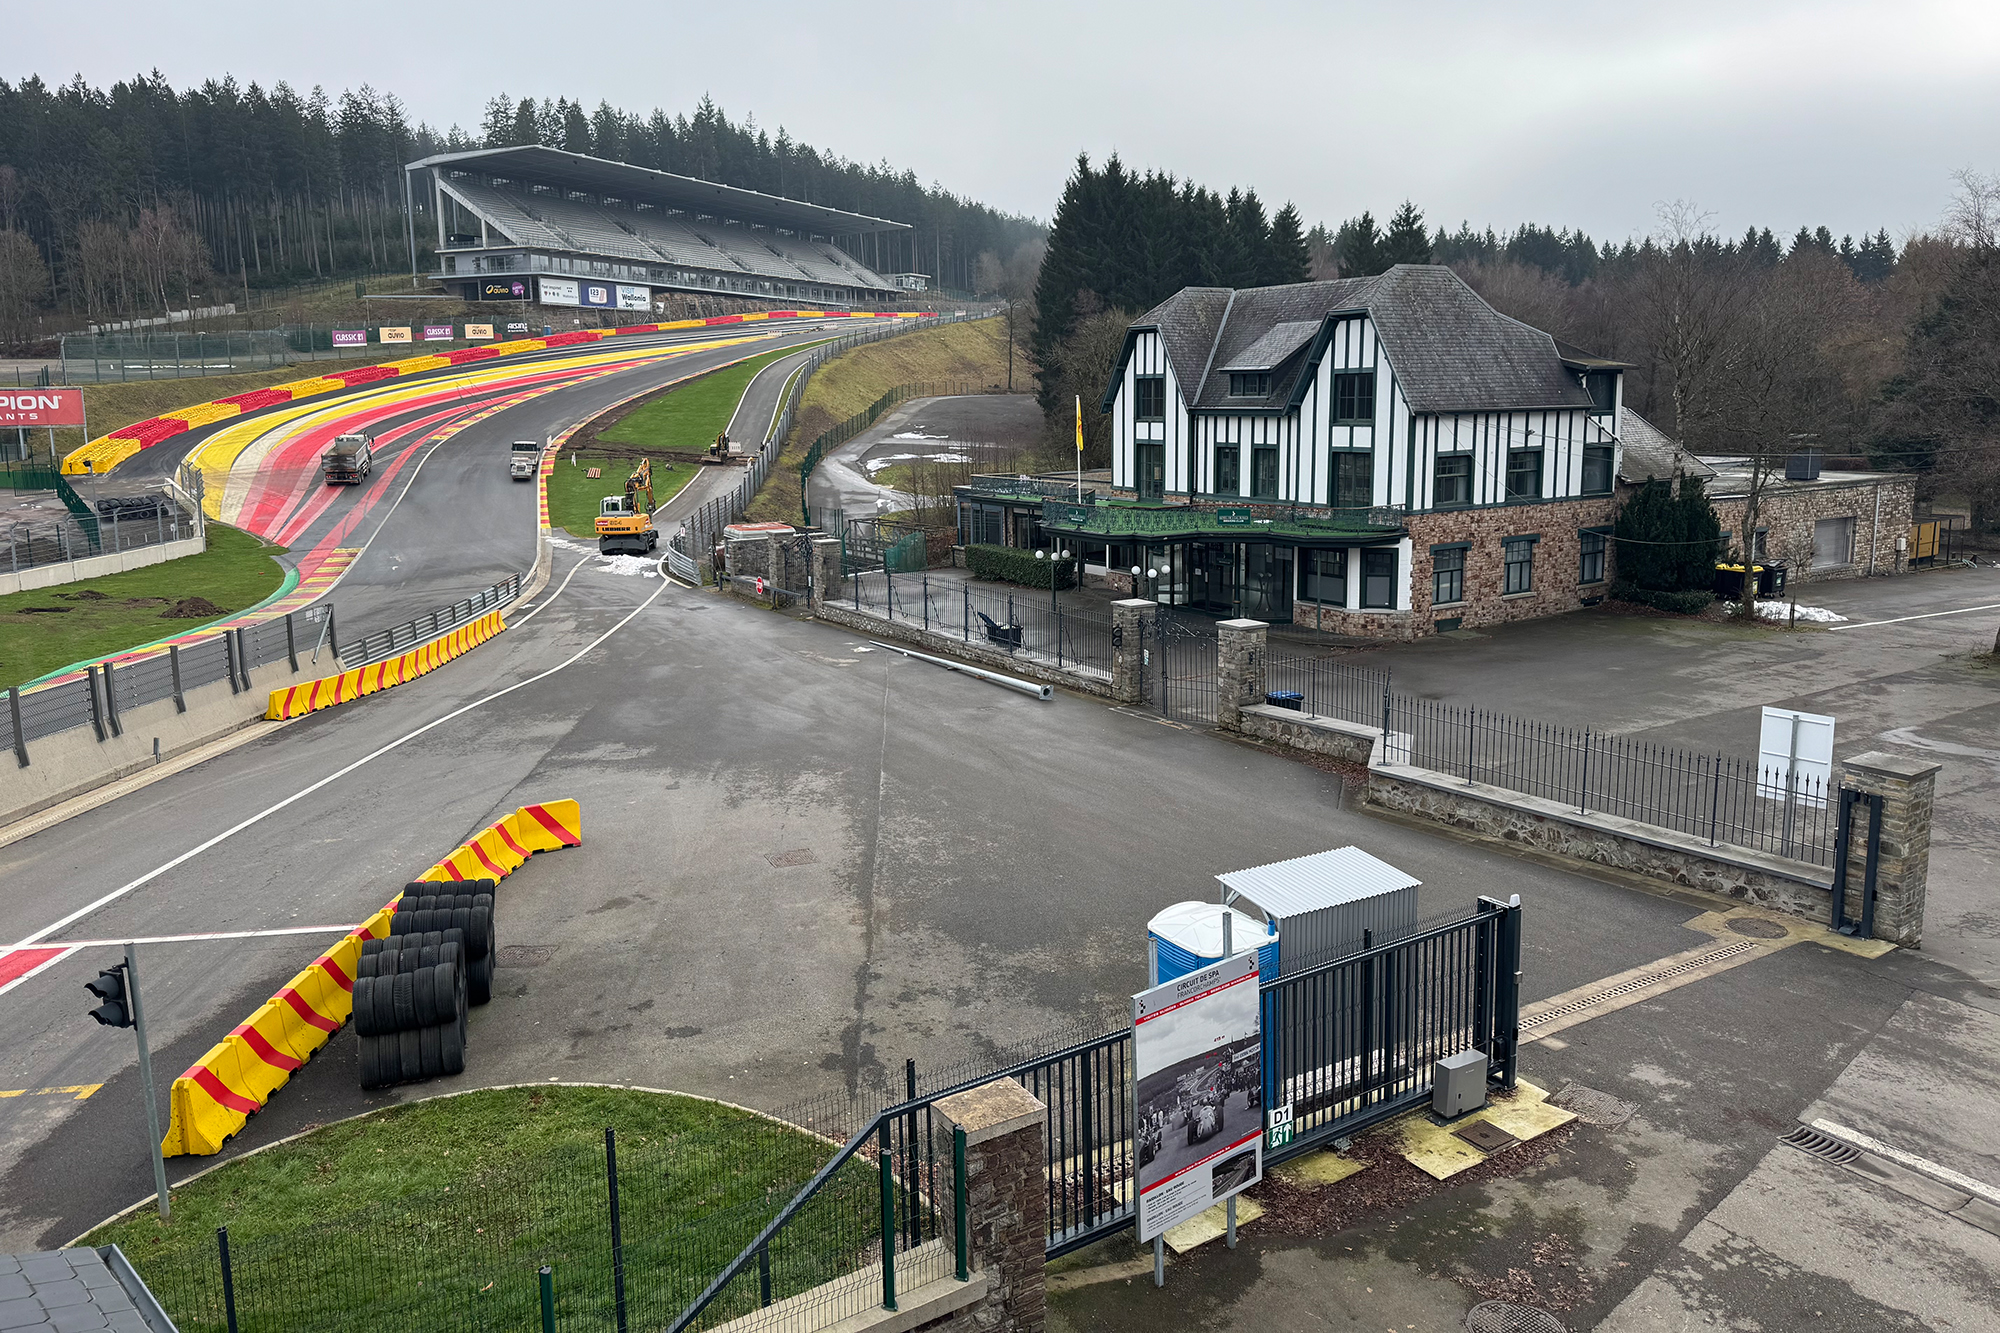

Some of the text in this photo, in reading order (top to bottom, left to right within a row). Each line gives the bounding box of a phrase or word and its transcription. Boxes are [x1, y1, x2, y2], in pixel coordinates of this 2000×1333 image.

[590, 288, 599, 296] 123
[620, 286, 635, 294] VISIT
[621, 293, 646, 302] Wallonia
[426, 328, 445, 336] CLASSIC
[335, 333, 357, 342] CLASSIC
[1176, 969, 1220, 992] CIRCUIT DE SPA
[1176, 977, 1220, 999] FRANCORCHAMPS
[1274, 1107, 1290, 1125] D1
